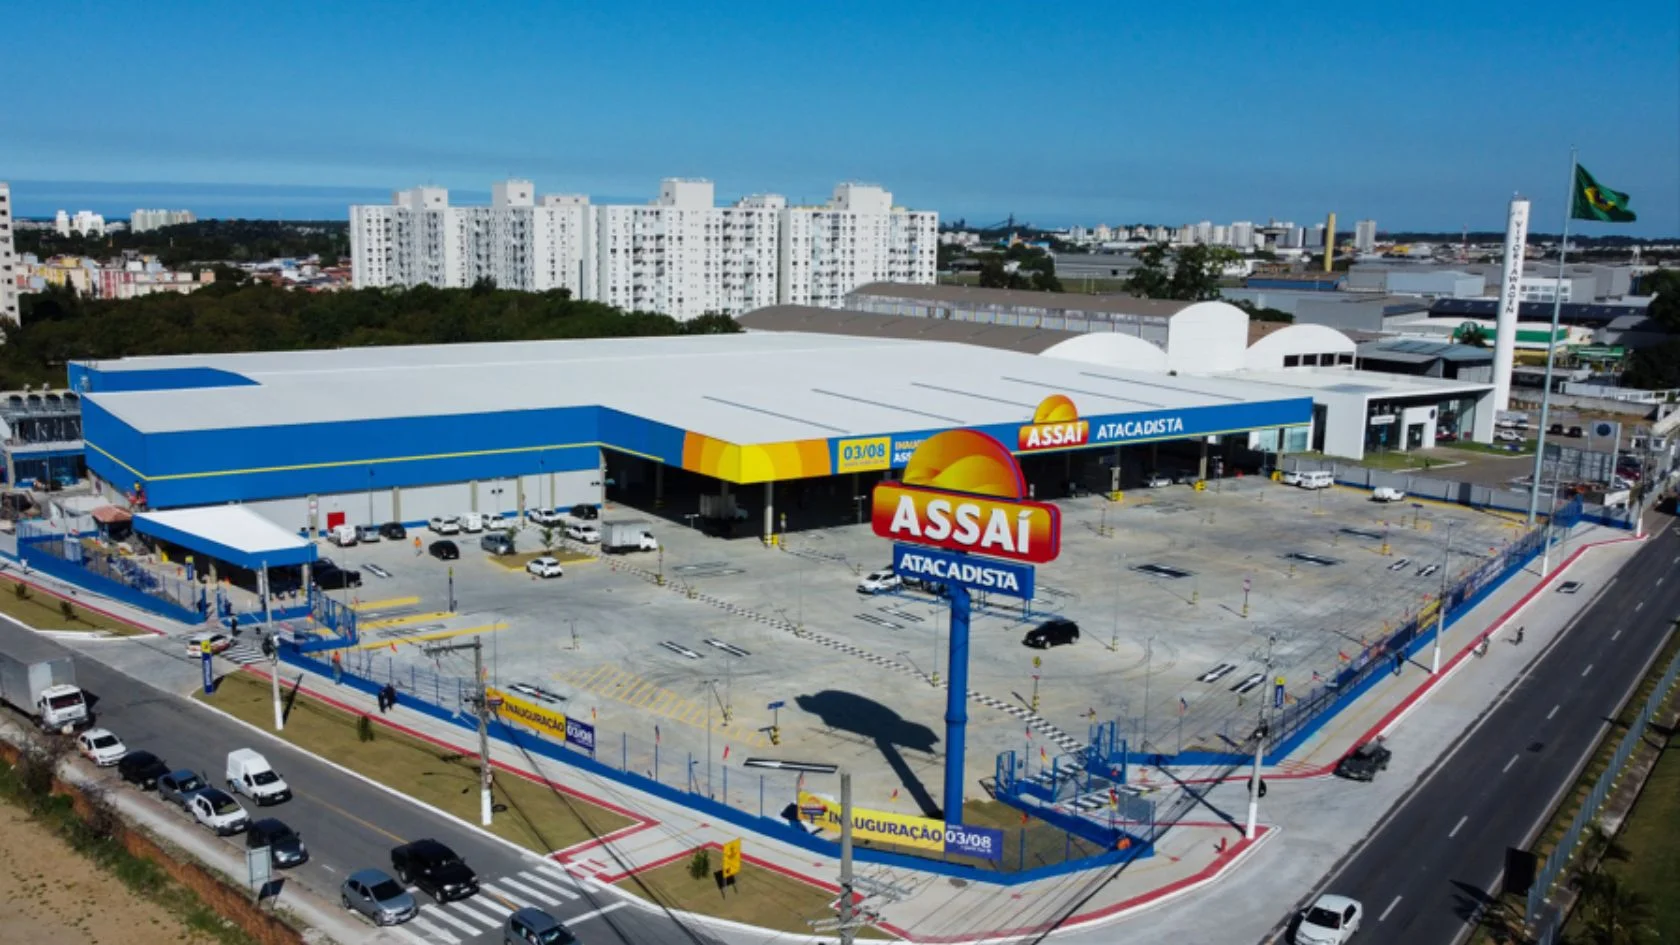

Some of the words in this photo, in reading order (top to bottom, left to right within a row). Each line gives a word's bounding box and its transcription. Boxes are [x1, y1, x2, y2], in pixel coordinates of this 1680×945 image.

[1097, 417, 1183, 440] ATACADISTA
[844, 443, 885, 460] 03/08
[900, 553, 1019, 592] ATACADISTA
[504, 701, 564, 732] INAUGURAÇÃO
[829, 809, 943, 843] INUGURAÇÃO
[945, 830, 992, 849] 03/08
